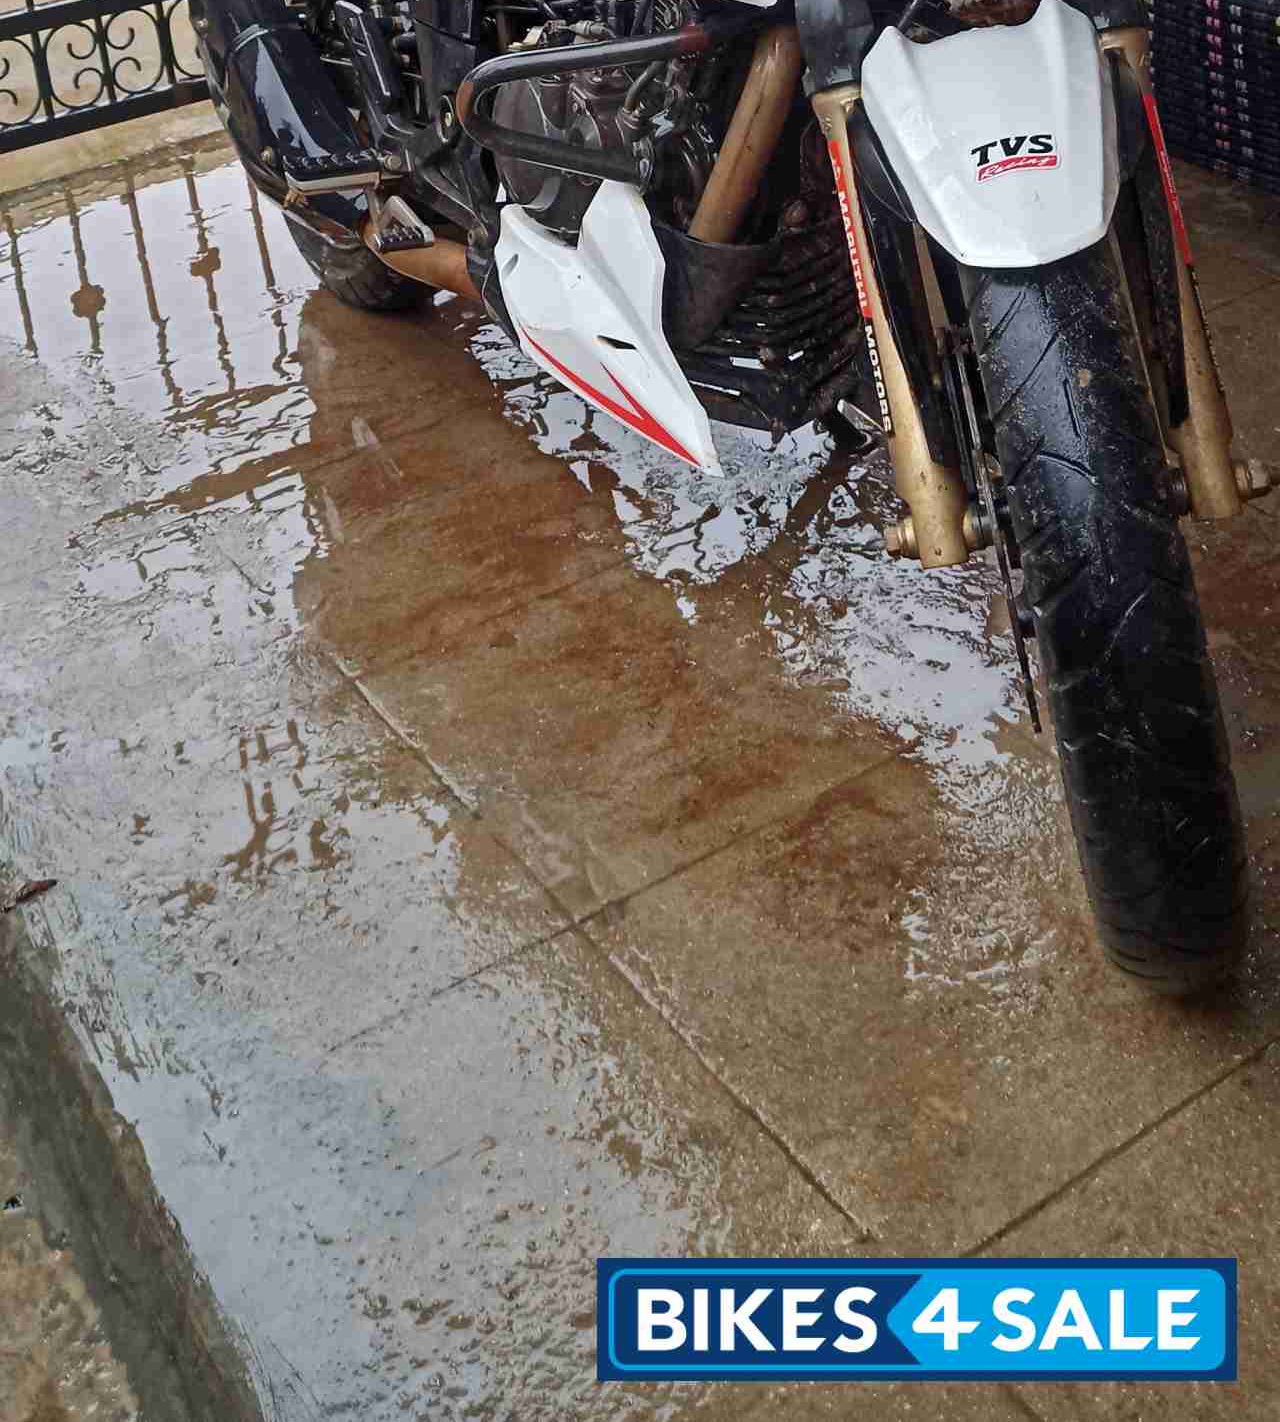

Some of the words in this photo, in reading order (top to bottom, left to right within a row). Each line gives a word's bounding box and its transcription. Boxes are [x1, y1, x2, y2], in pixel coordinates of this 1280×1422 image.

[971, 134, 1053, 167] TVS
[979, 156, 1054, 180] Racing
[864, 325, 892, 433] MOTORS
